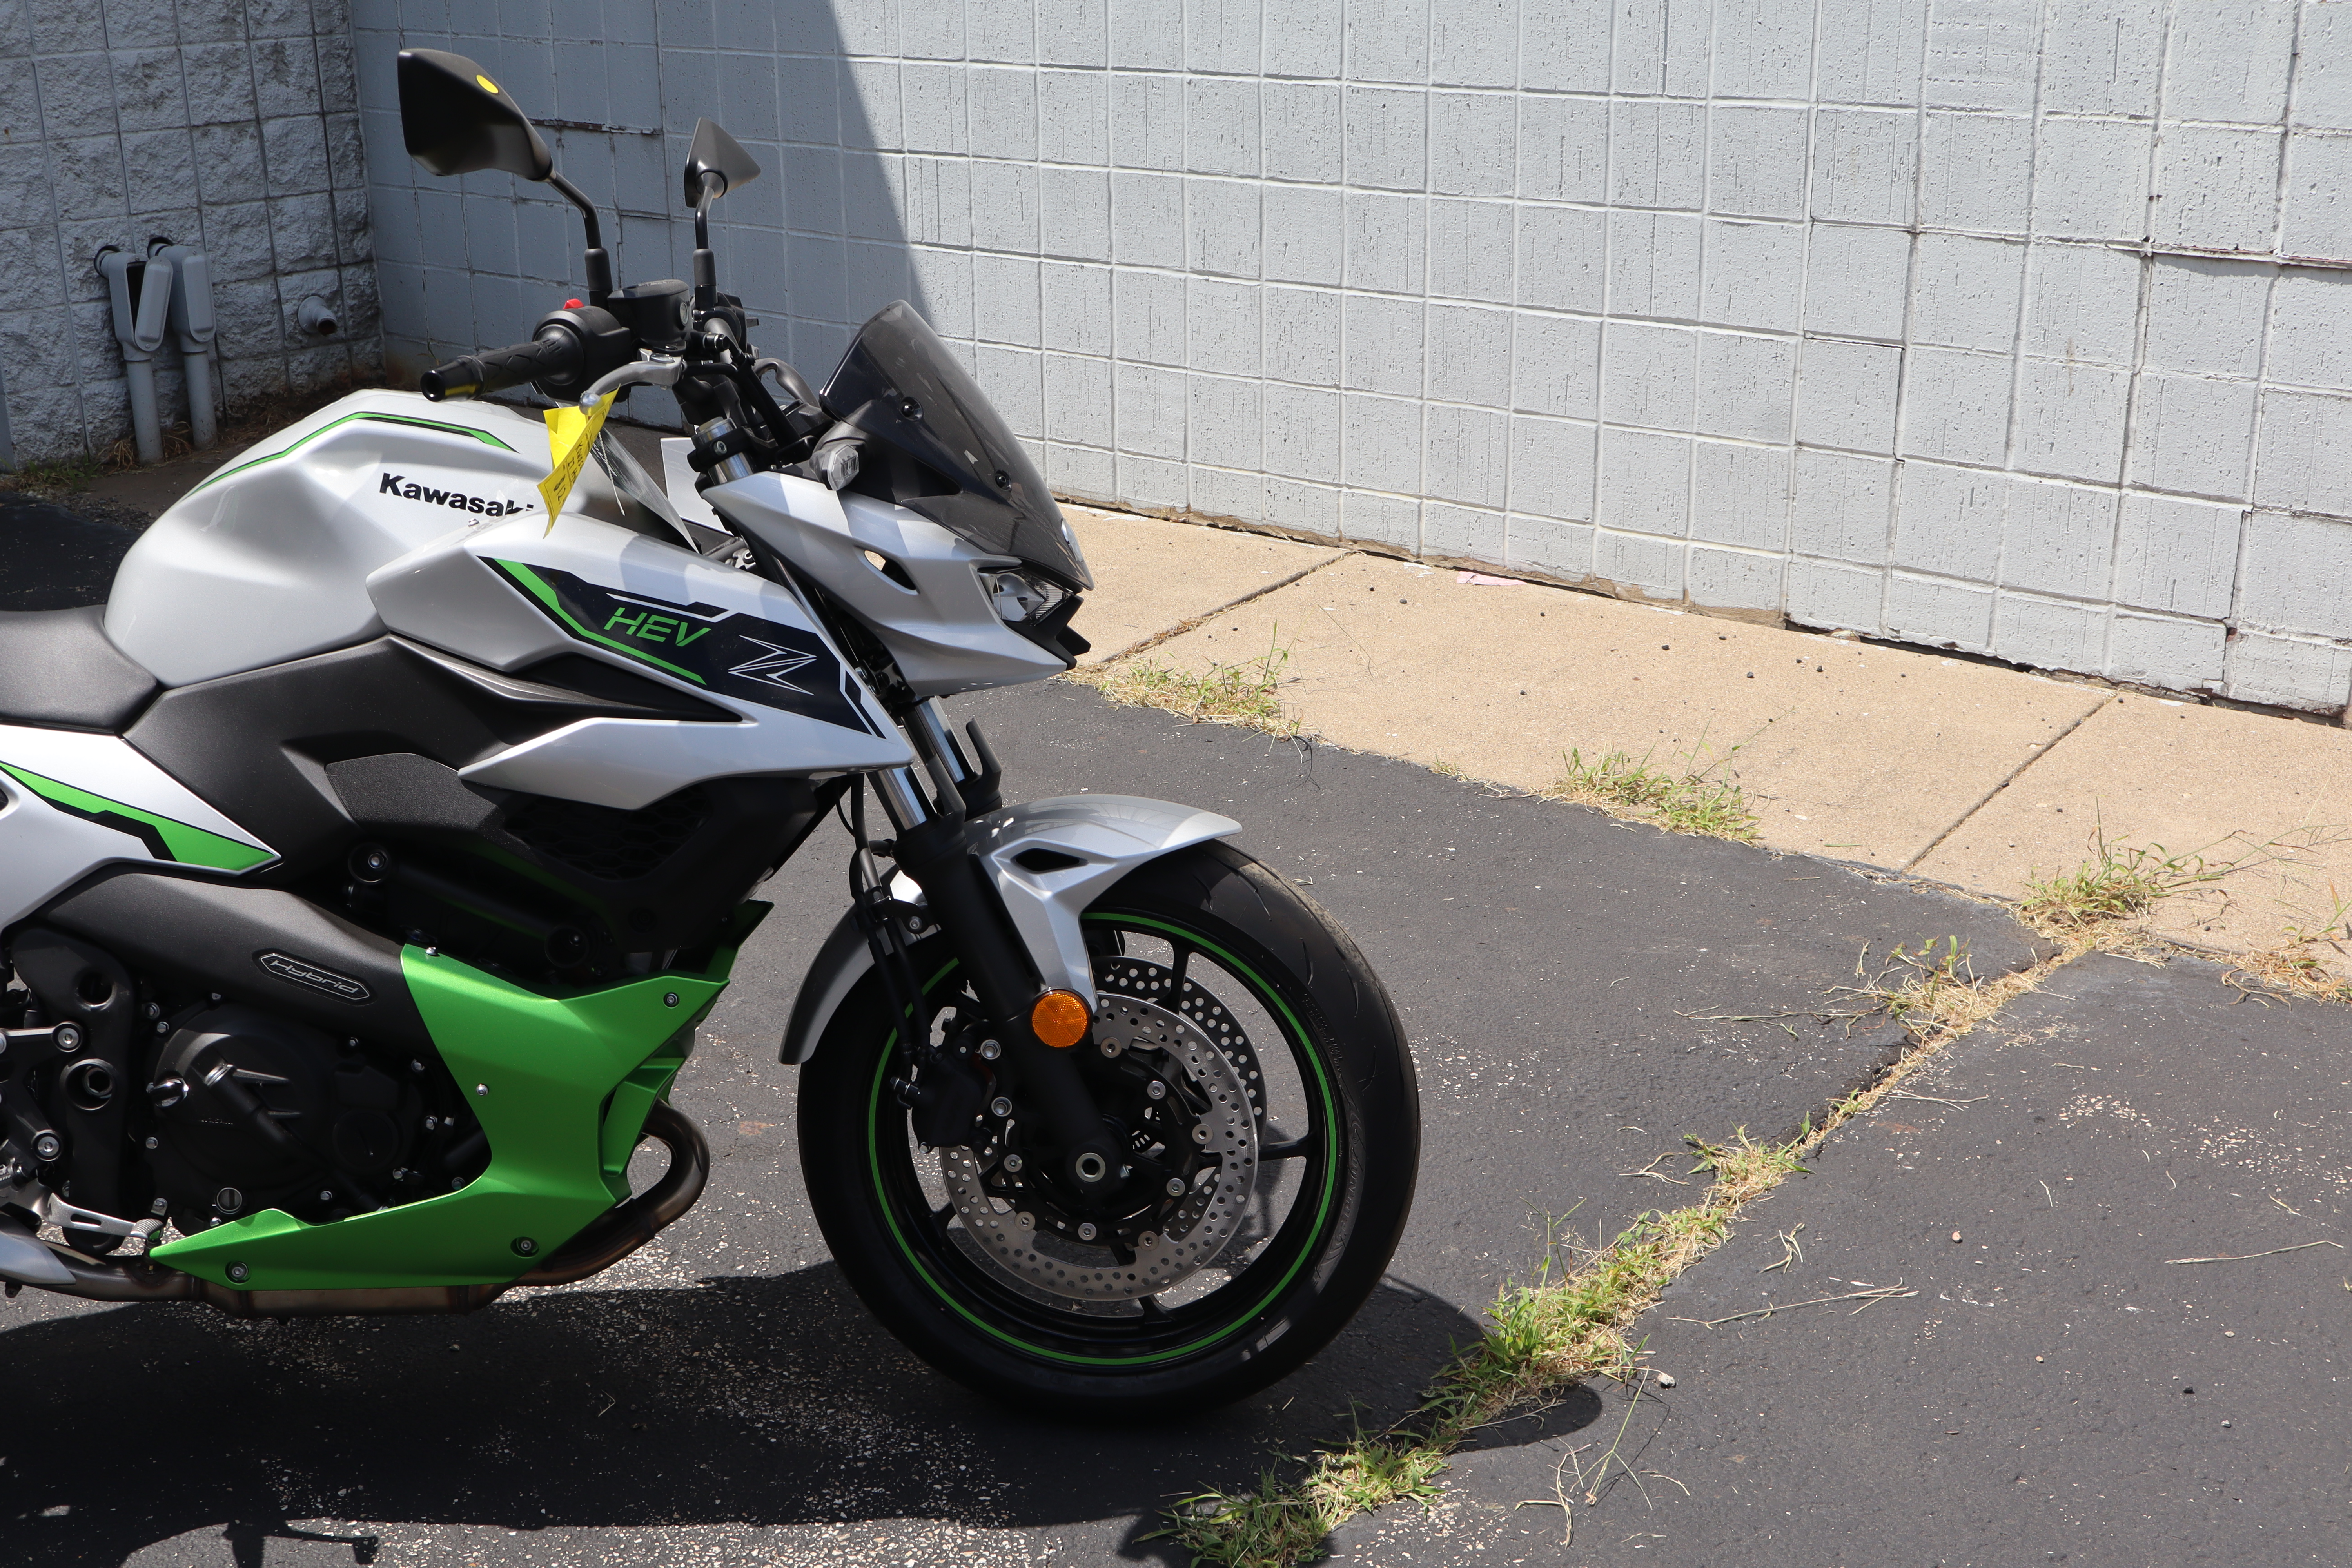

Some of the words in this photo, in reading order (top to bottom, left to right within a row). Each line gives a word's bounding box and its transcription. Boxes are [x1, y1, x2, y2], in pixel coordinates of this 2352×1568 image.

[604, 607, 711, 646] HEV
[270, 960, 359, 993] Hybrid
[1341, 1156, 1359, 1232] DUNLOP
